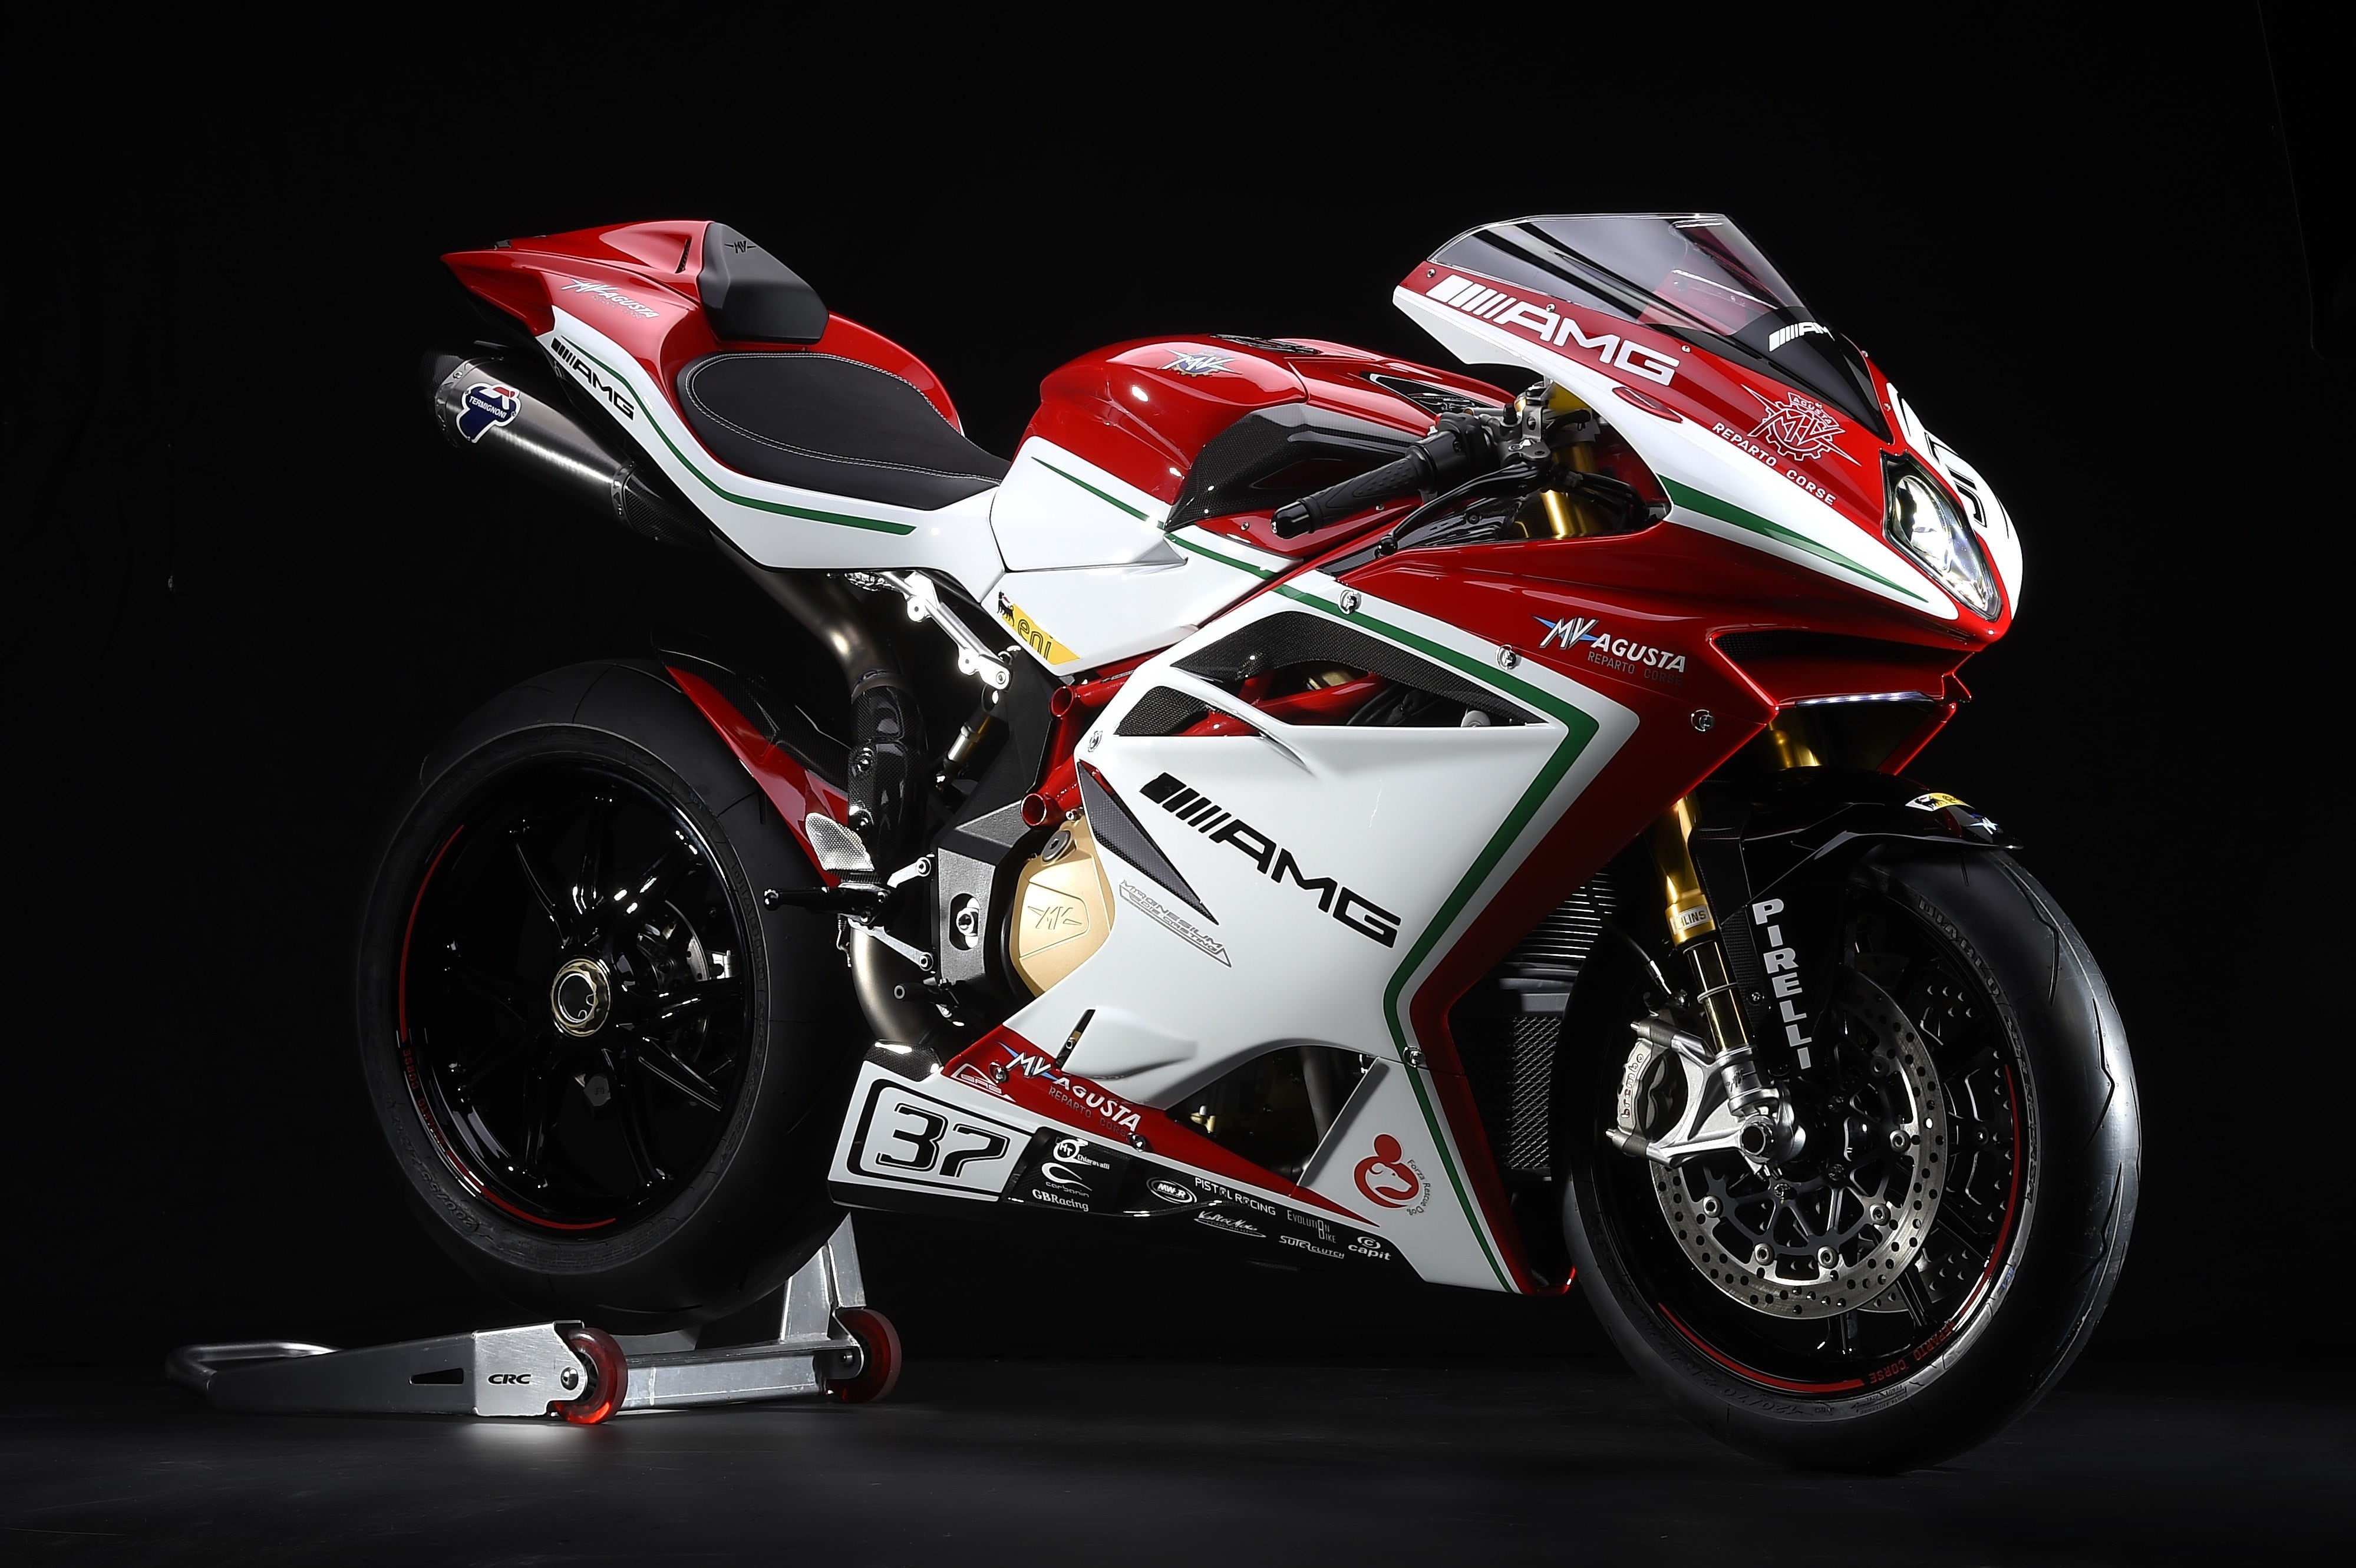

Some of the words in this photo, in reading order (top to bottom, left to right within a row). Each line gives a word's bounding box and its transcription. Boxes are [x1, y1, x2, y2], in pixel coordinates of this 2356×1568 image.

[599, 291, 660, 319] AGUSTA
[1493, 300, 1680, 386] AMG
[469, 395, 507, 419] TERMIGNONI
[570, 361, 635, 420] AMG
[1793, 395, 1832, 425] AGUSTA
[1712, 422, 1777, 467] REPARTO
[1786, 469, 1837, 506] CORSE
[1017, 619, 1053, 661] eni
[1539, 617, 1599, 650] MV
[1591, 632, 1687, 674] AGUSTA
[1587, 650, 1635, 674] REPARTO
[1643, 666, 1683, 686] CORSE
[1208, 818, 1402, 949] AMG
[1121, 879, 1223, 949] MAGNESIUM
[1919, 894, 2001, 997] DIABLO
[1752, 897, 1812, 1070] PIRELLI
[402, 1048, 419, 1090] CORSE
[1621, 1053, 1645, 1118] brembo
[1005, 1051, 1051, 1078] MV
[1052, 1077, 1141, 1131] AGUSTA
[1049, 1085, 1093, 1118] REPARTO
[1099, 1116, 1128, 1138] CORS
[875, 1102, 1011, 1178] 37
[1045, 1181, 1090, 1198] carbonin
[1407, 1159, 1425, 1181] Forza
[1032, 1189, 1089, 1212] GBRacing
[1406, 1205, 1424, 1216] Dog
[1421, 1182, 1431, 1207] Rescue
[1348, 1244, 1392, 1261] capit
[1911, 1319, 1957, 1362] REPARTO
[487, 1373, 533, 1385] CRC
[1867, 1357, 1909, 1385] CORSE
